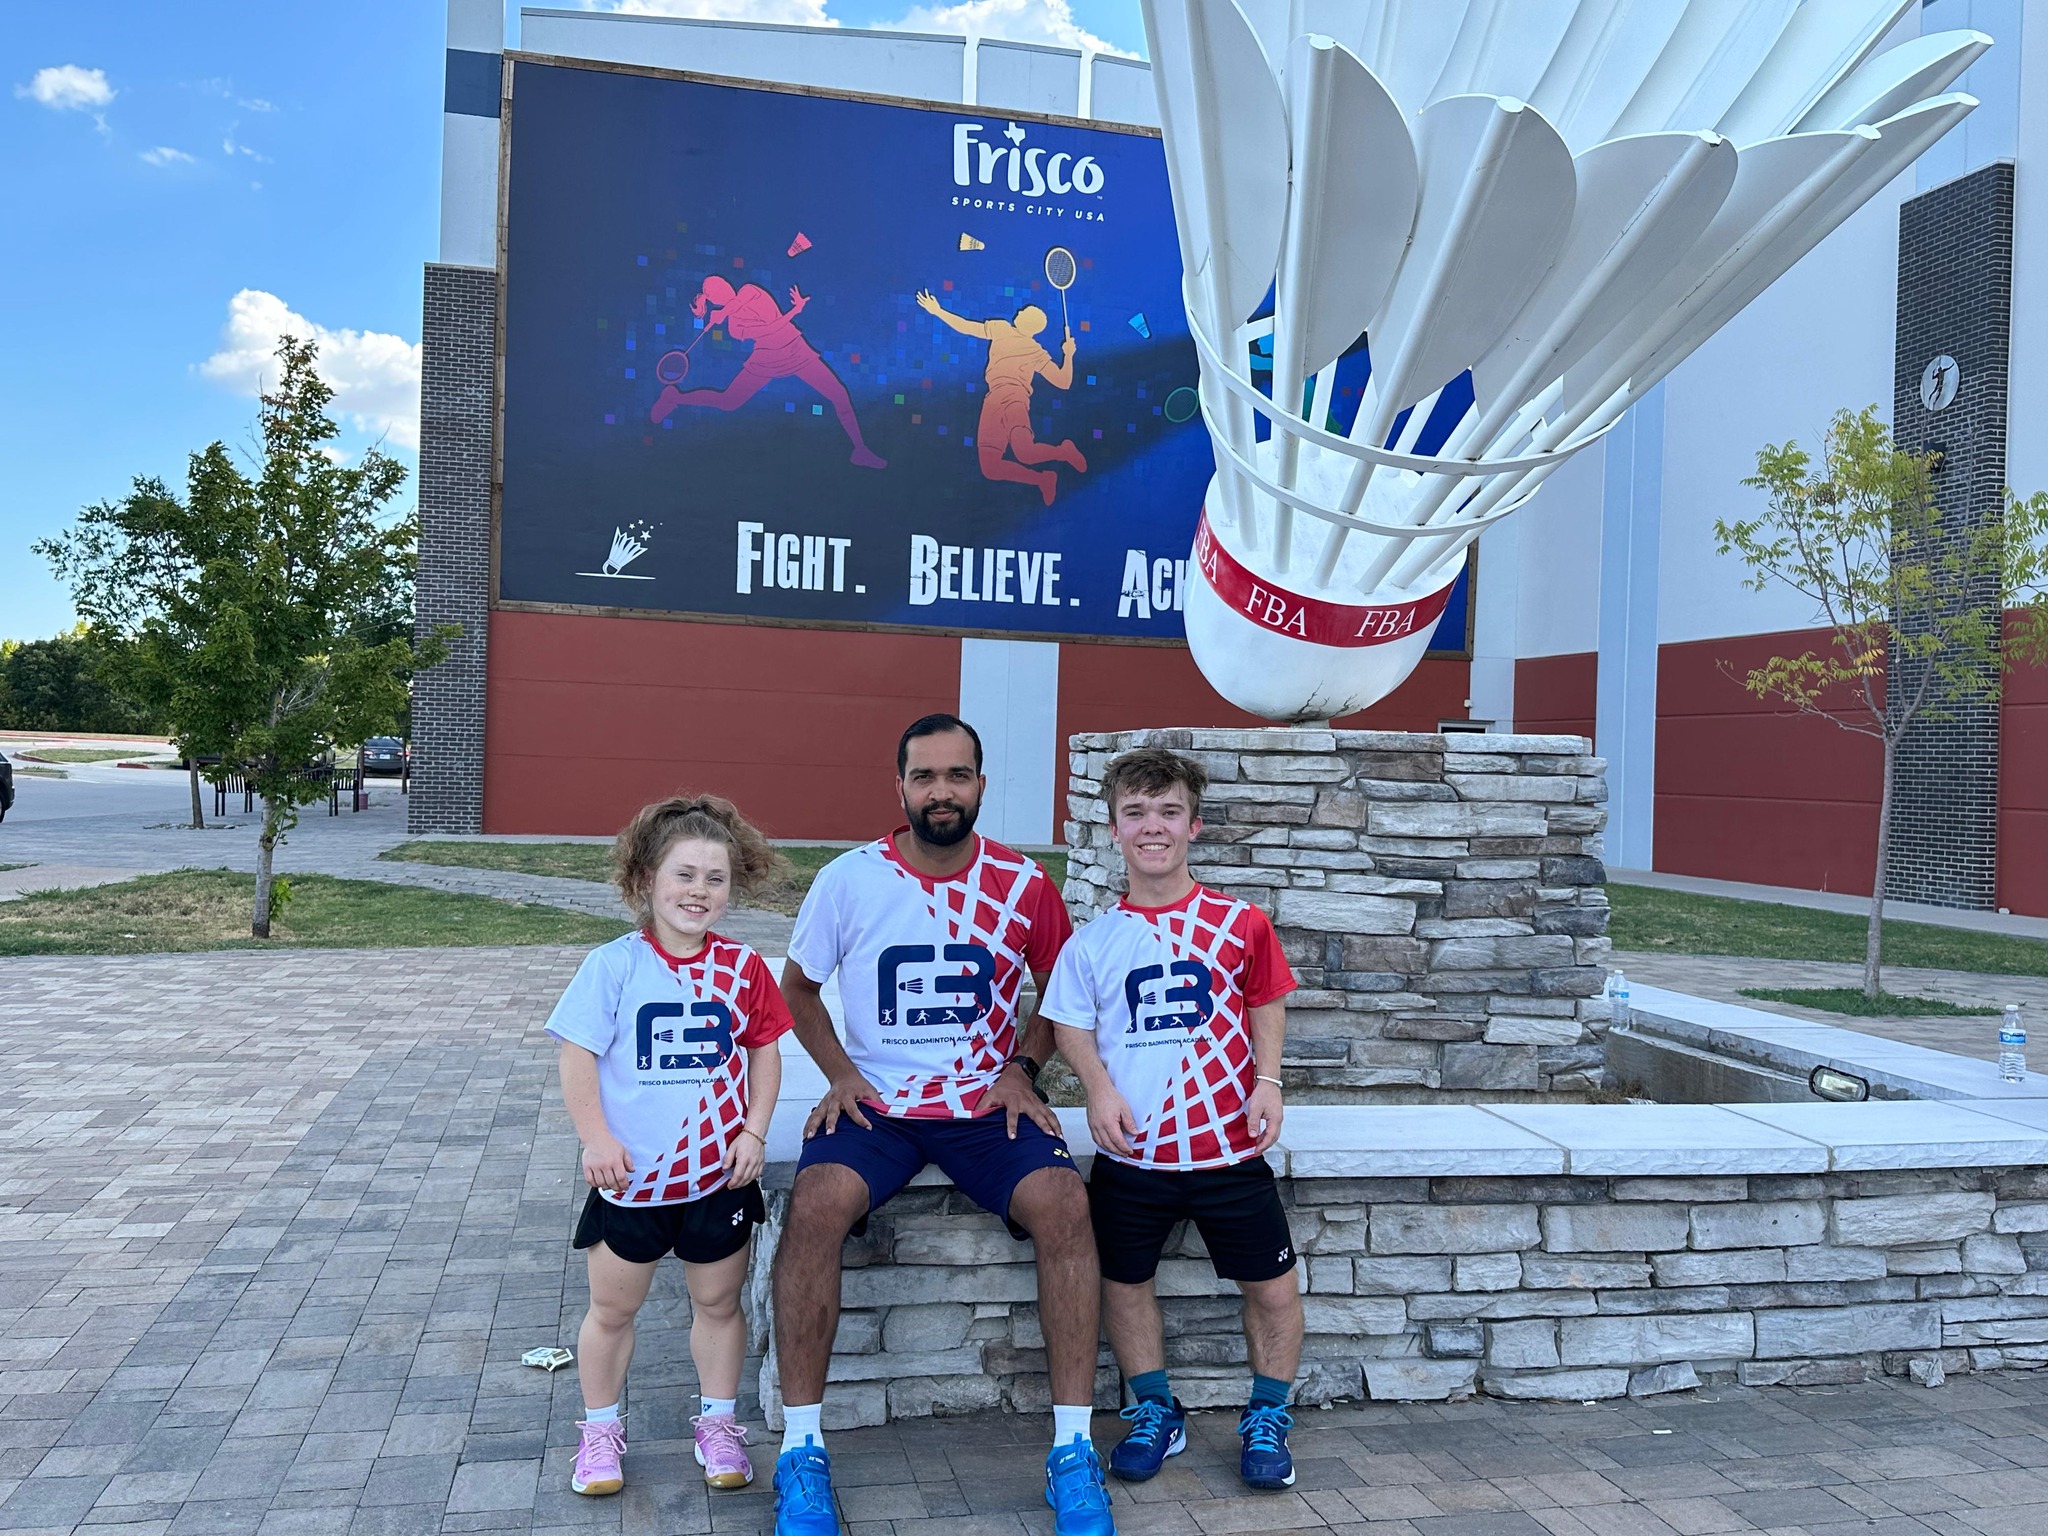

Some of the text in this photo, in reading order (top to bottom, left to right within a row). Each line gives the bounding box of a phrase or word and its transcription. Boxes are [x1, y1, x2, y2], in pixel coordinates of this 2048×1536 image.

[953, 122, 1105, 197] Frisco
[951, 196, 1105, 222] SPORTS CITY USA
[1244, 582, 1307, 637] FBA
[1354, 606, 1417, 639] FBA
[881, 1038, 909, 1046] FRISCO
[910, 1036, 955, 1046] BADMINTON
[662, 1077, 701, 1087] BADMINTON
